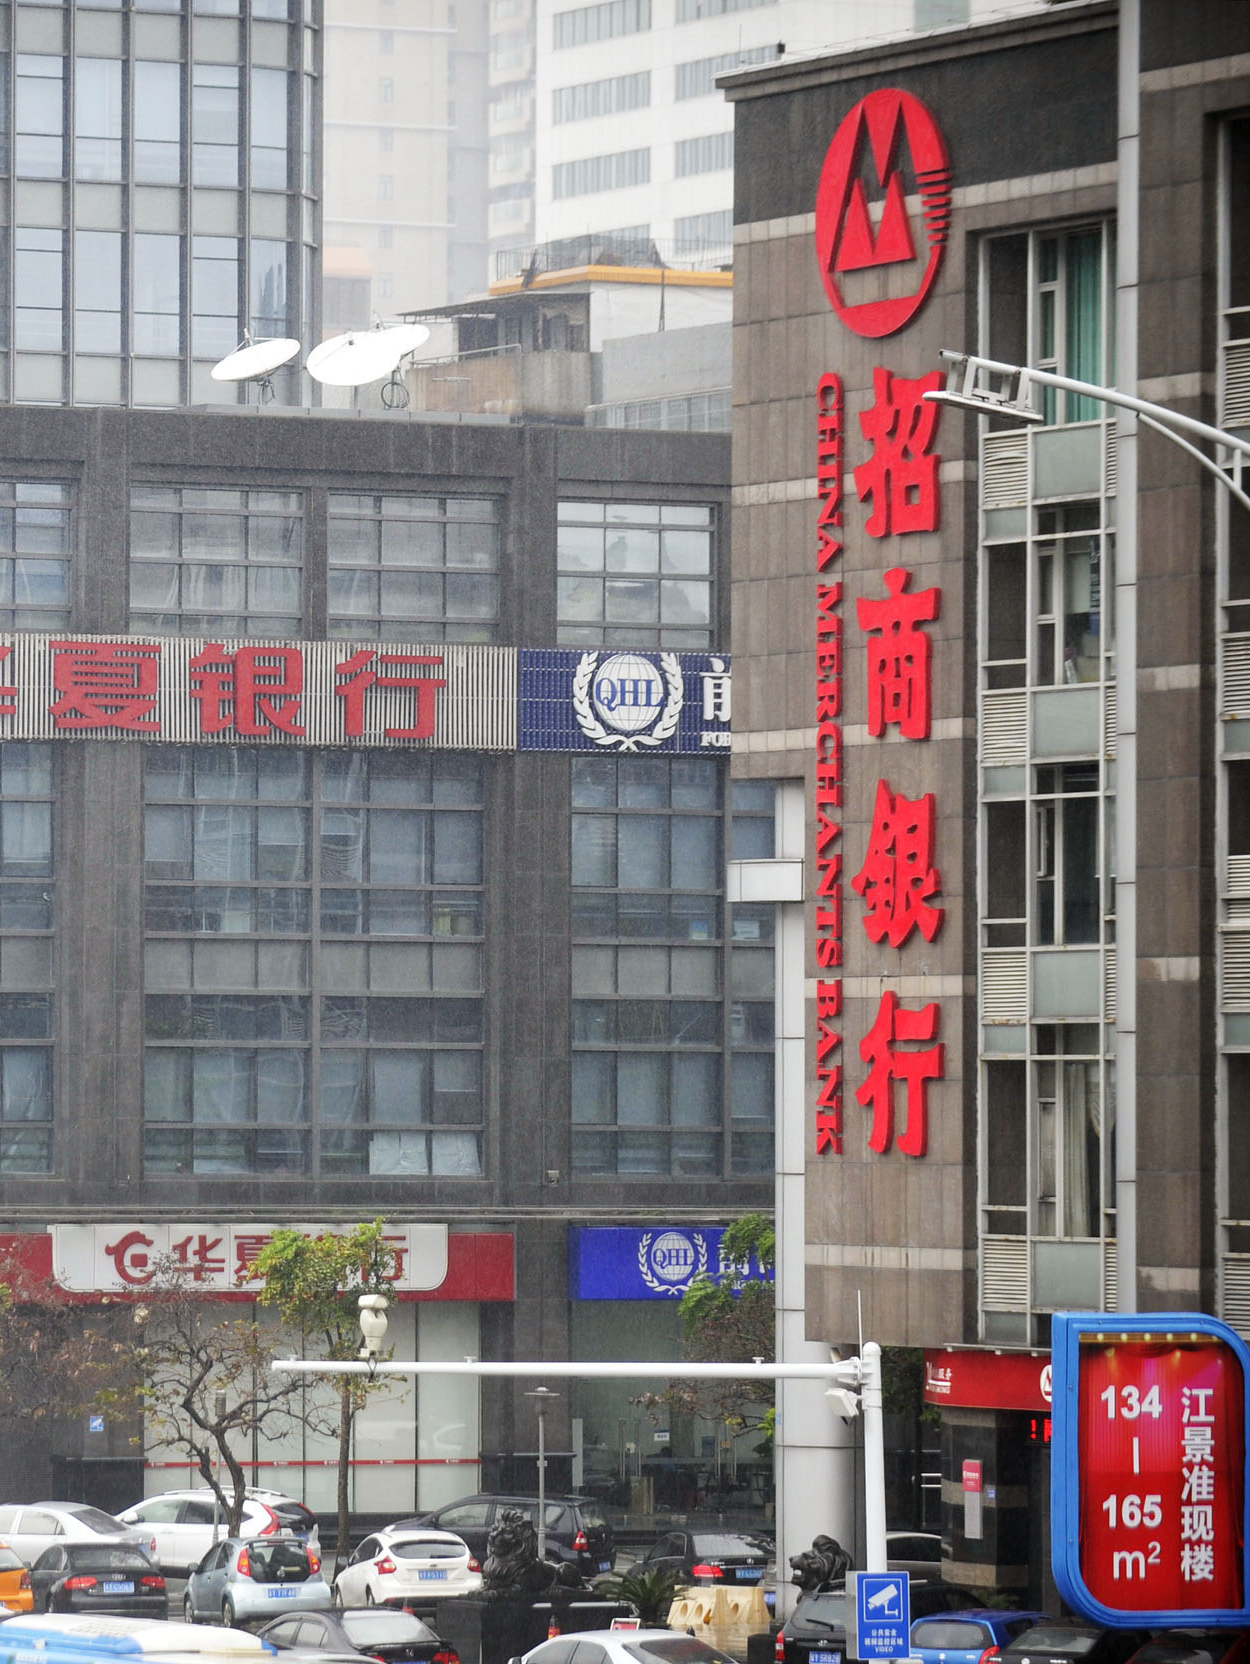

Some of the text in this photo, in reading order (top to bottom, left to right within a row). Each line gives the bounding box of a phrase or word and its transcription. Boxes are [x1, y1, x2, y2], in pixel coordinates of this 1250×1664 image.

[595, 677, 666, 712] QHL
[816, 372, 843, 1156] CHINA MERCHANTS BANK
[852, 367, 946, 1157] 招商银行
[1101, 1384, 1163, 1420] 134
[1102, 1493, 1163, 1529] 165
[1181, 1386, 1215, 1582] 江景准现楼
